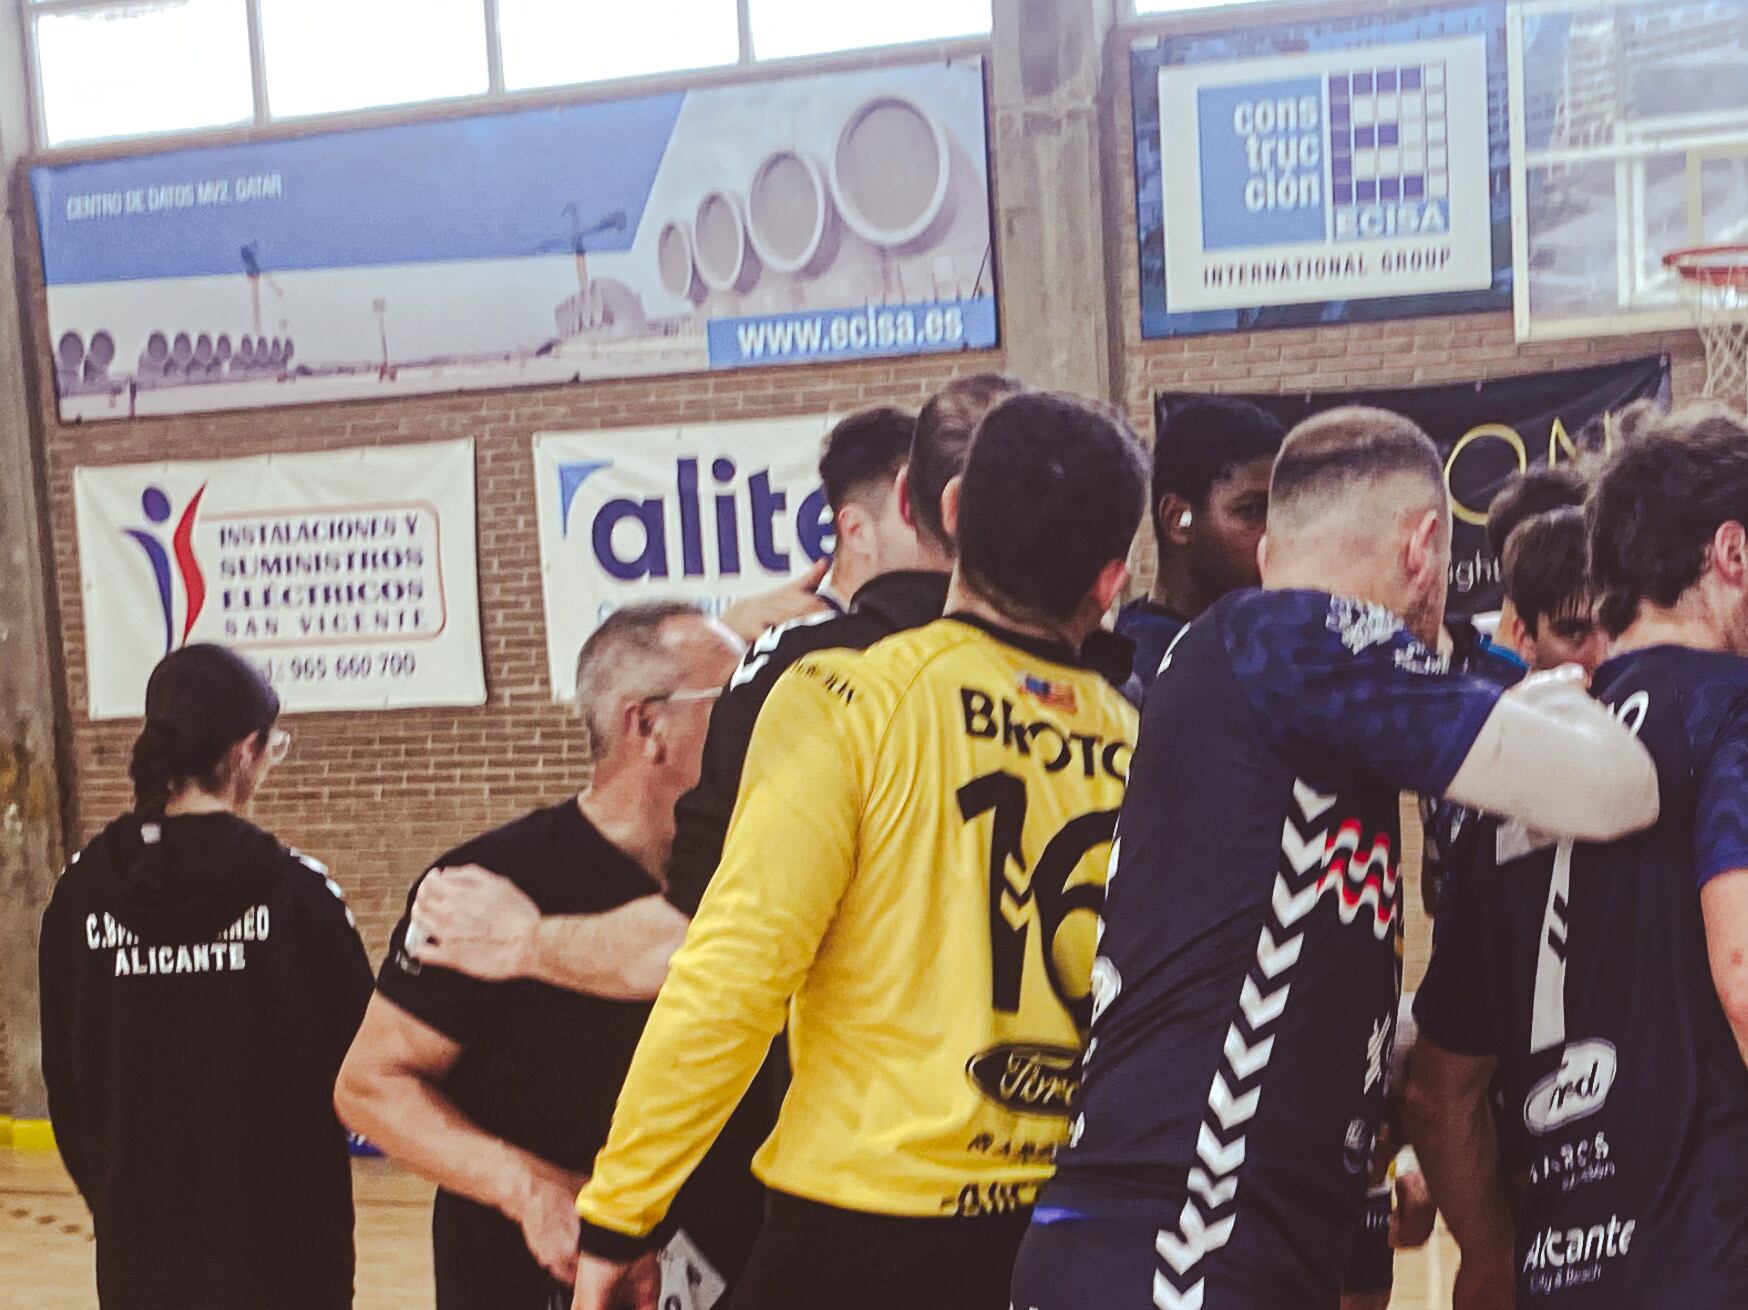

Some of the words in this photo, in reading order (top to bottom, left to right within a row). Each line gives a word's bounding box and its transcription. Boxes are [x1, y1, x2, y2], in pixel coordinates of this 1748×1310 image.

[1334, 201, 1447, 239] ECISA
[1203, 253, 1367, 289] INTERNATIONAL
[1381, 245, 1451, 273] GROUP
[737, 304, 963, 359] www.ecisa.es
[220, 517, 397, 549] INSTALACIONES
[406, 513, 418, 537] Y
[221, 548, 424, 579] SUMINISTROS
[225, 616, 279, 637] SAN
[300, 608, 420, 635] VICENTE
[380, 650, 416, 676] 700
[115, 942, 246, 977] ALICANTE
